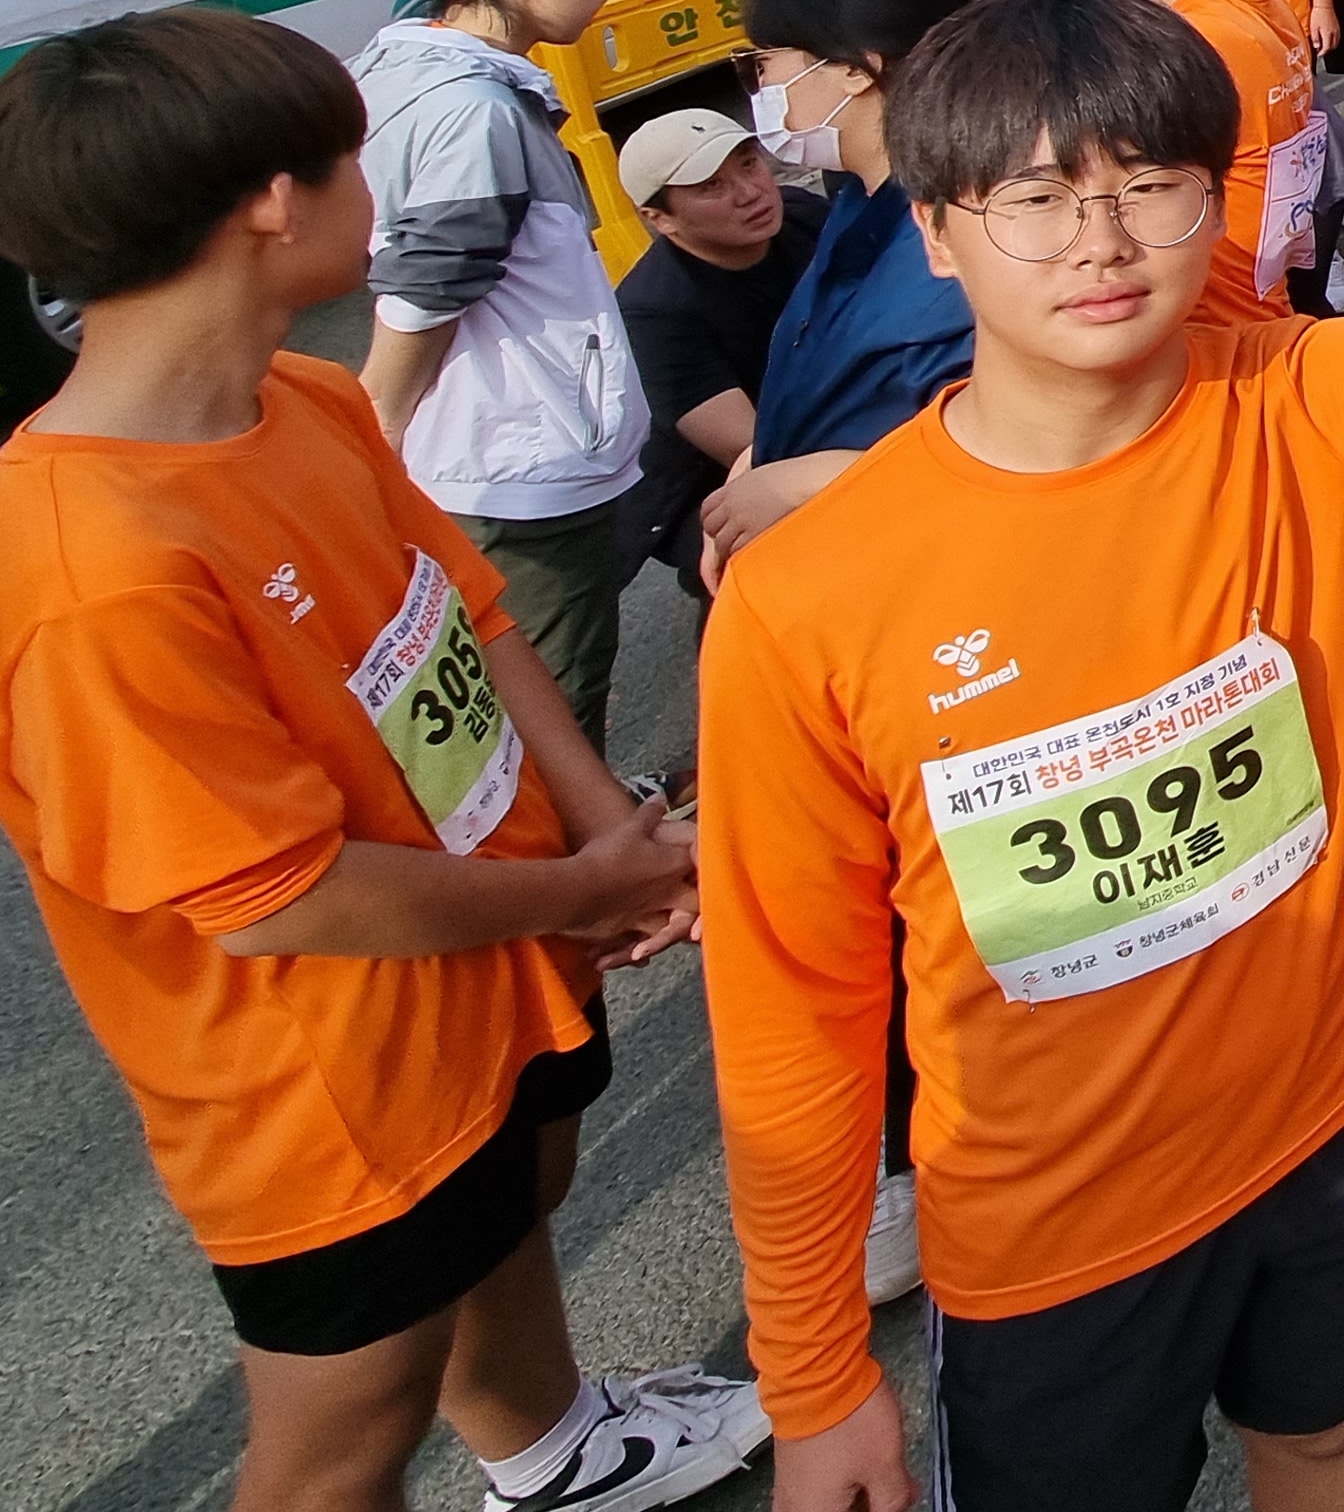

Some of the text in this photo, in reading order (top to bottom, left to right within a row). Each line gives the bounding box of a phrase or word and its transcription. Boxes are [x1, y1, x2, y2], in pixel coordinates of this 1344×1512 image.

[928, 658, 1021, 714] hummel
[947, 657, 1280, 815] 제17회 창녕 부곡온천 마라톤대회
[972, 654, 1247, 778] 대한민국 대표 온천도시 1호 지정 기념
[1010, 725, 1262, 884] 3095
[1092, 821, 1225, 904] 이재훈
[1050, 954, 1099, 979] 창녕군
